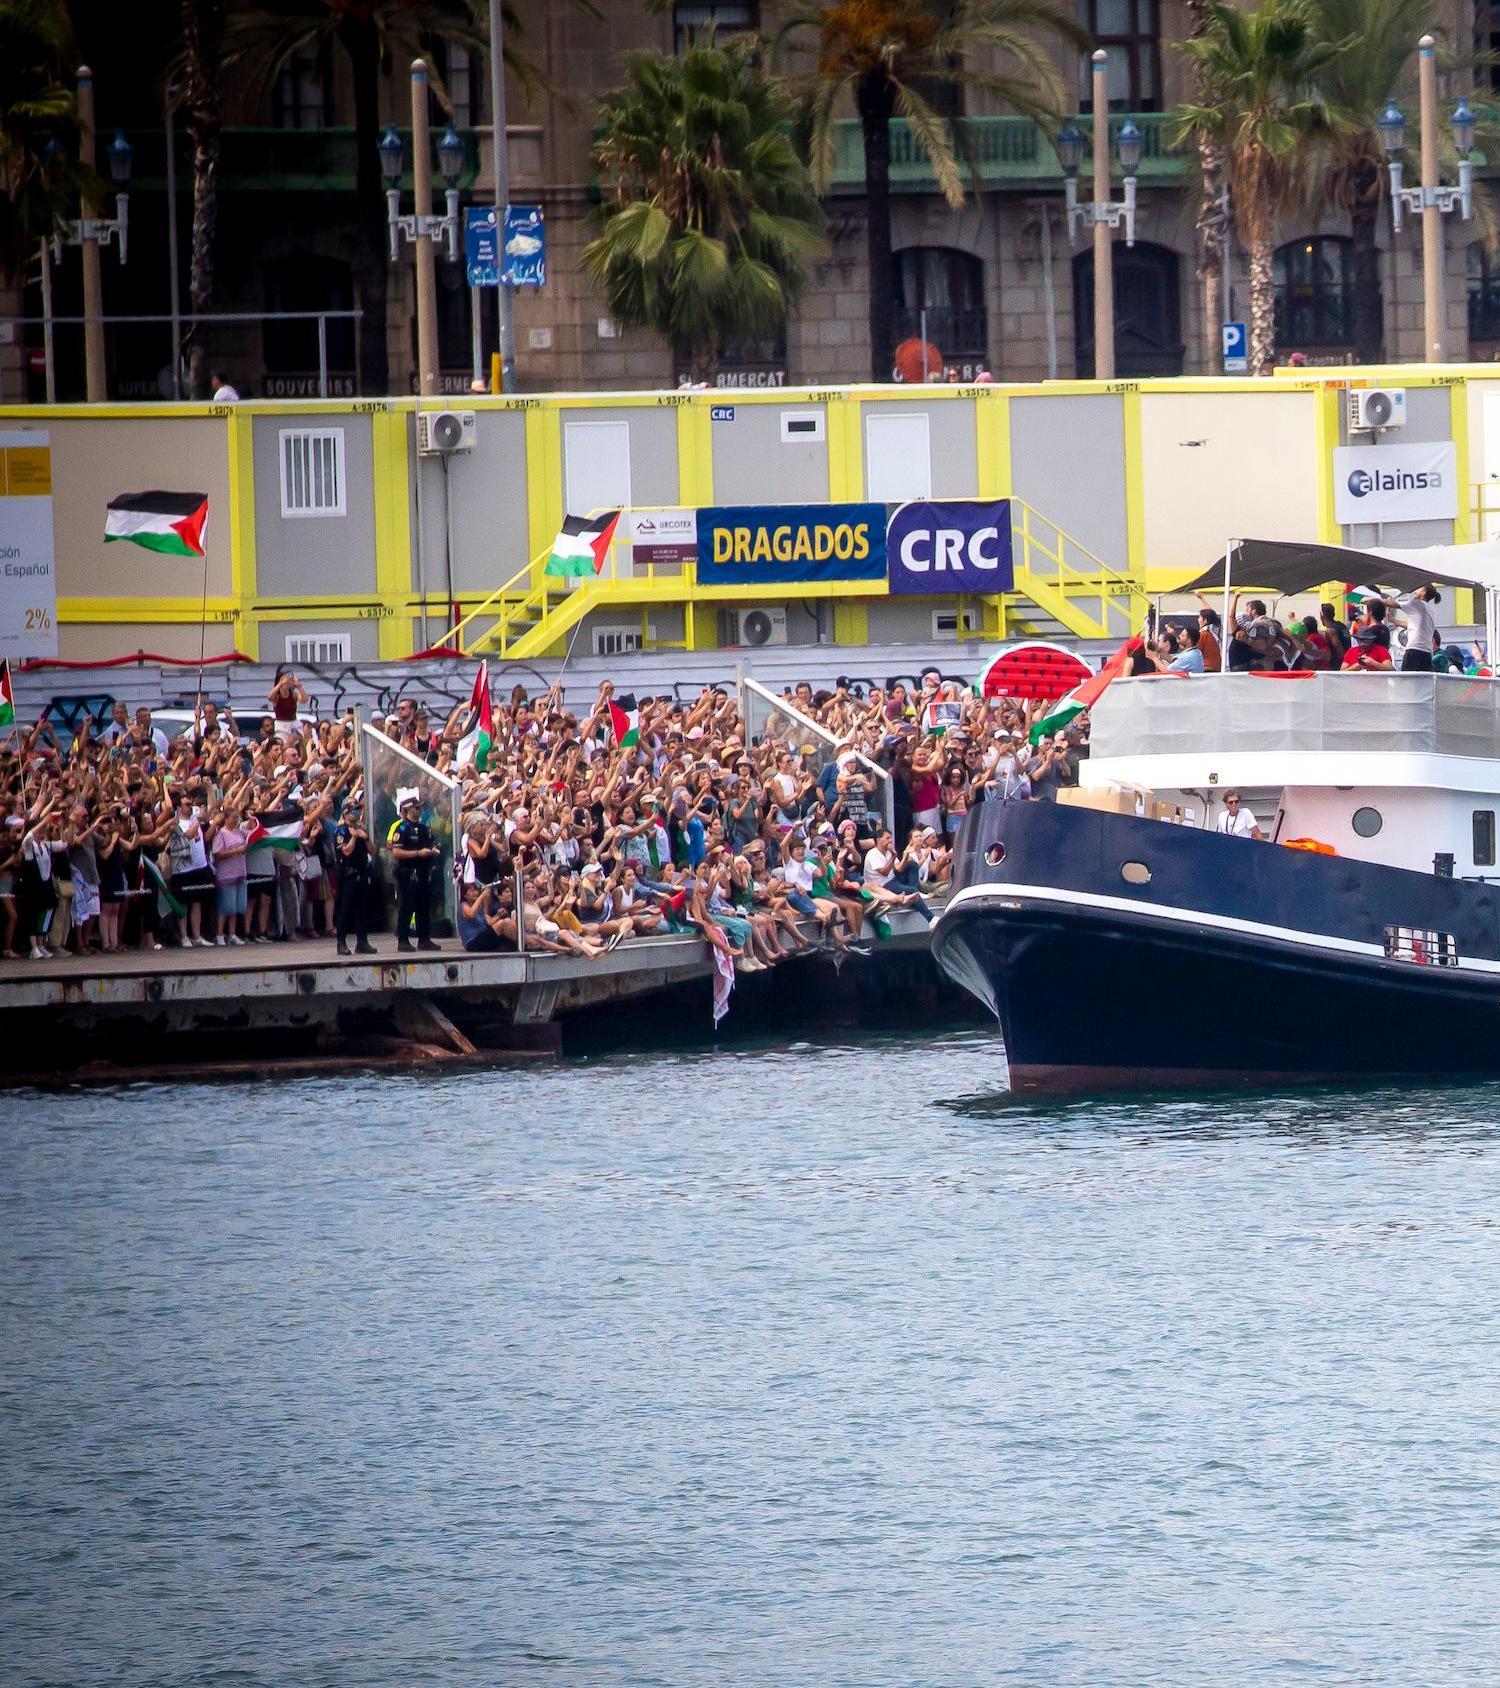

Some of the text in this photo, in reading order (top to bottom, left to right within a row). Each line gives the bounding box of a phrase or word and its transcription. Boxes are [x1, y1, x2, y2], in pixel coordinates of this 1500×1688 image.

[1223, 327, 1240, 354] P
[712, 408, 734, 420] CRC
[1359, 468, 1442, 492] alainsa
[713, 523, 870, 563] DRAGADOS
[901, 527, 999, 572] CRC
[5, 563, 49, 578] Español
[25, 608, 51, 630] 2%
